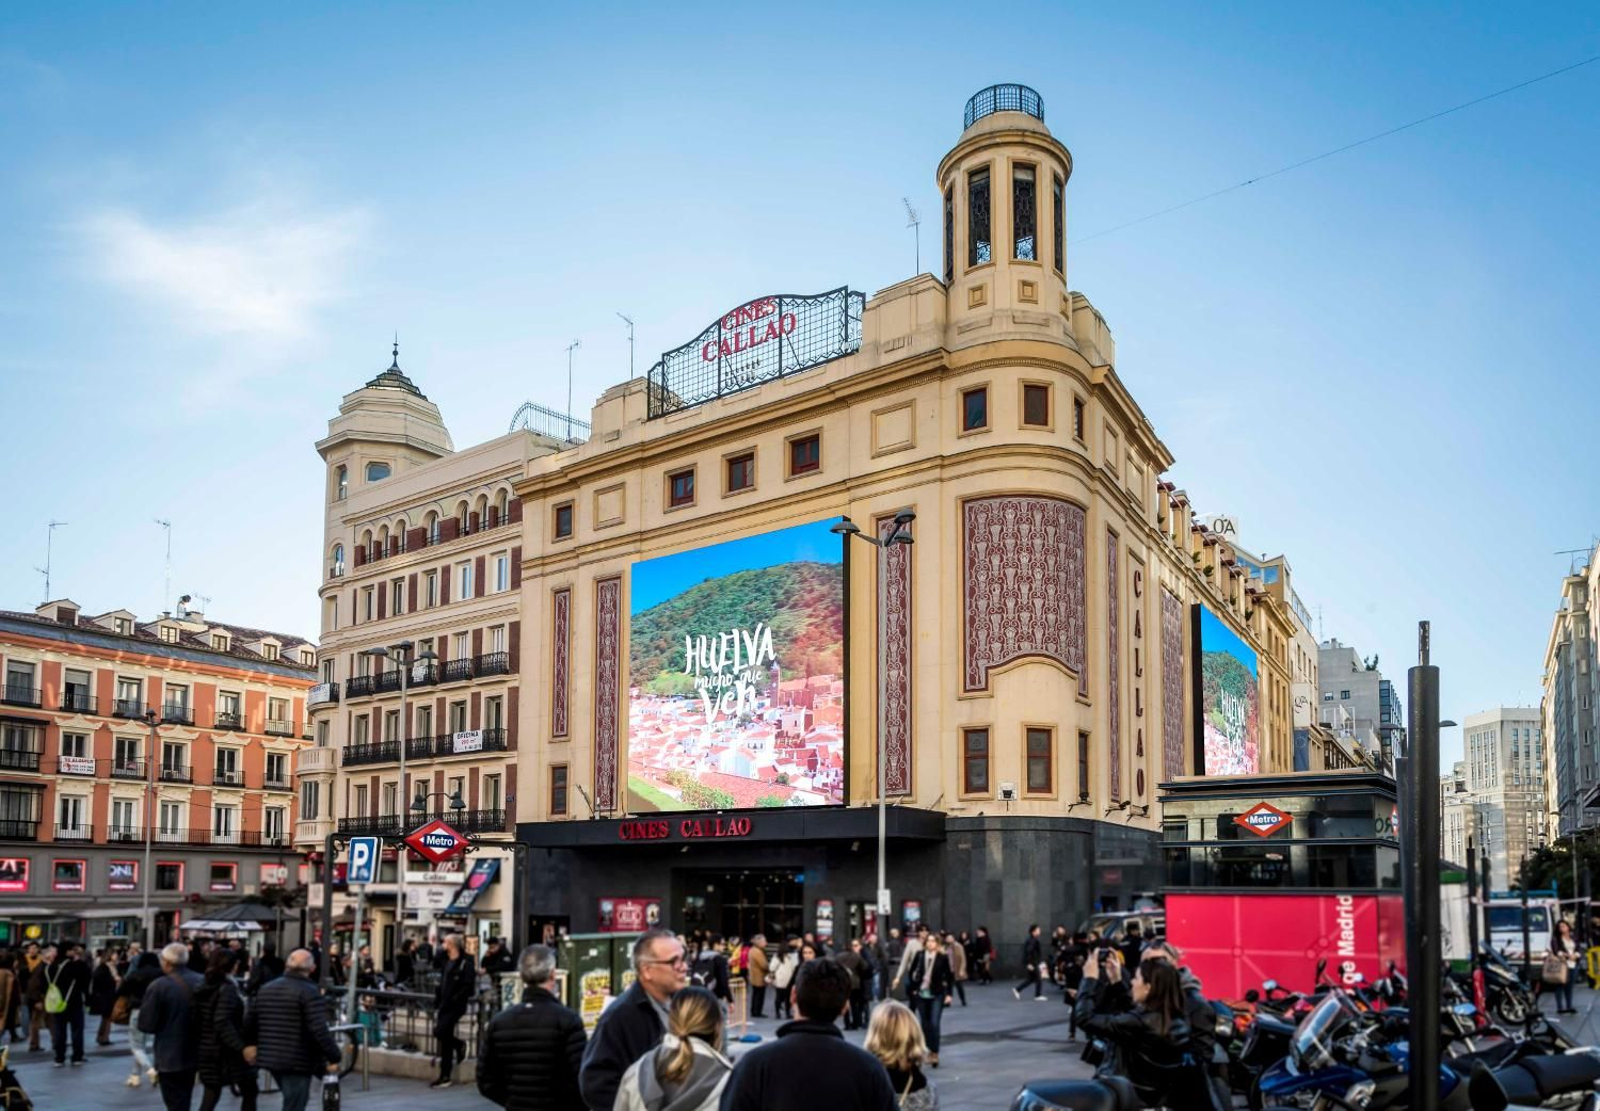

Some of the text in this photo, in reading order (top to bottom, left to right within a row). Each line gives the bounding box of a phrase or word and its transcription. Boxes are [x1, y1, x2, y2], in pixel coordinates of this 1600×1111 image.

[721, 295, 776, 331] CINES
[702, 312, 797, 362] CALLAO
[683, 622, 777, 676] HUELVA
[694, 669, 763, 692] mucho que
[1133, 569, 1145, 797] CALLAO
[457, 731, 479, 740] OFICINA
[619, 817, 752, 841] CINES CALLAO
[1249, 815, 1278, 824] Metro
[426, 835, 453, 847] Metro
[351, 843, 369, 879] P
[1336, 895, 1355, 956] Madrid
